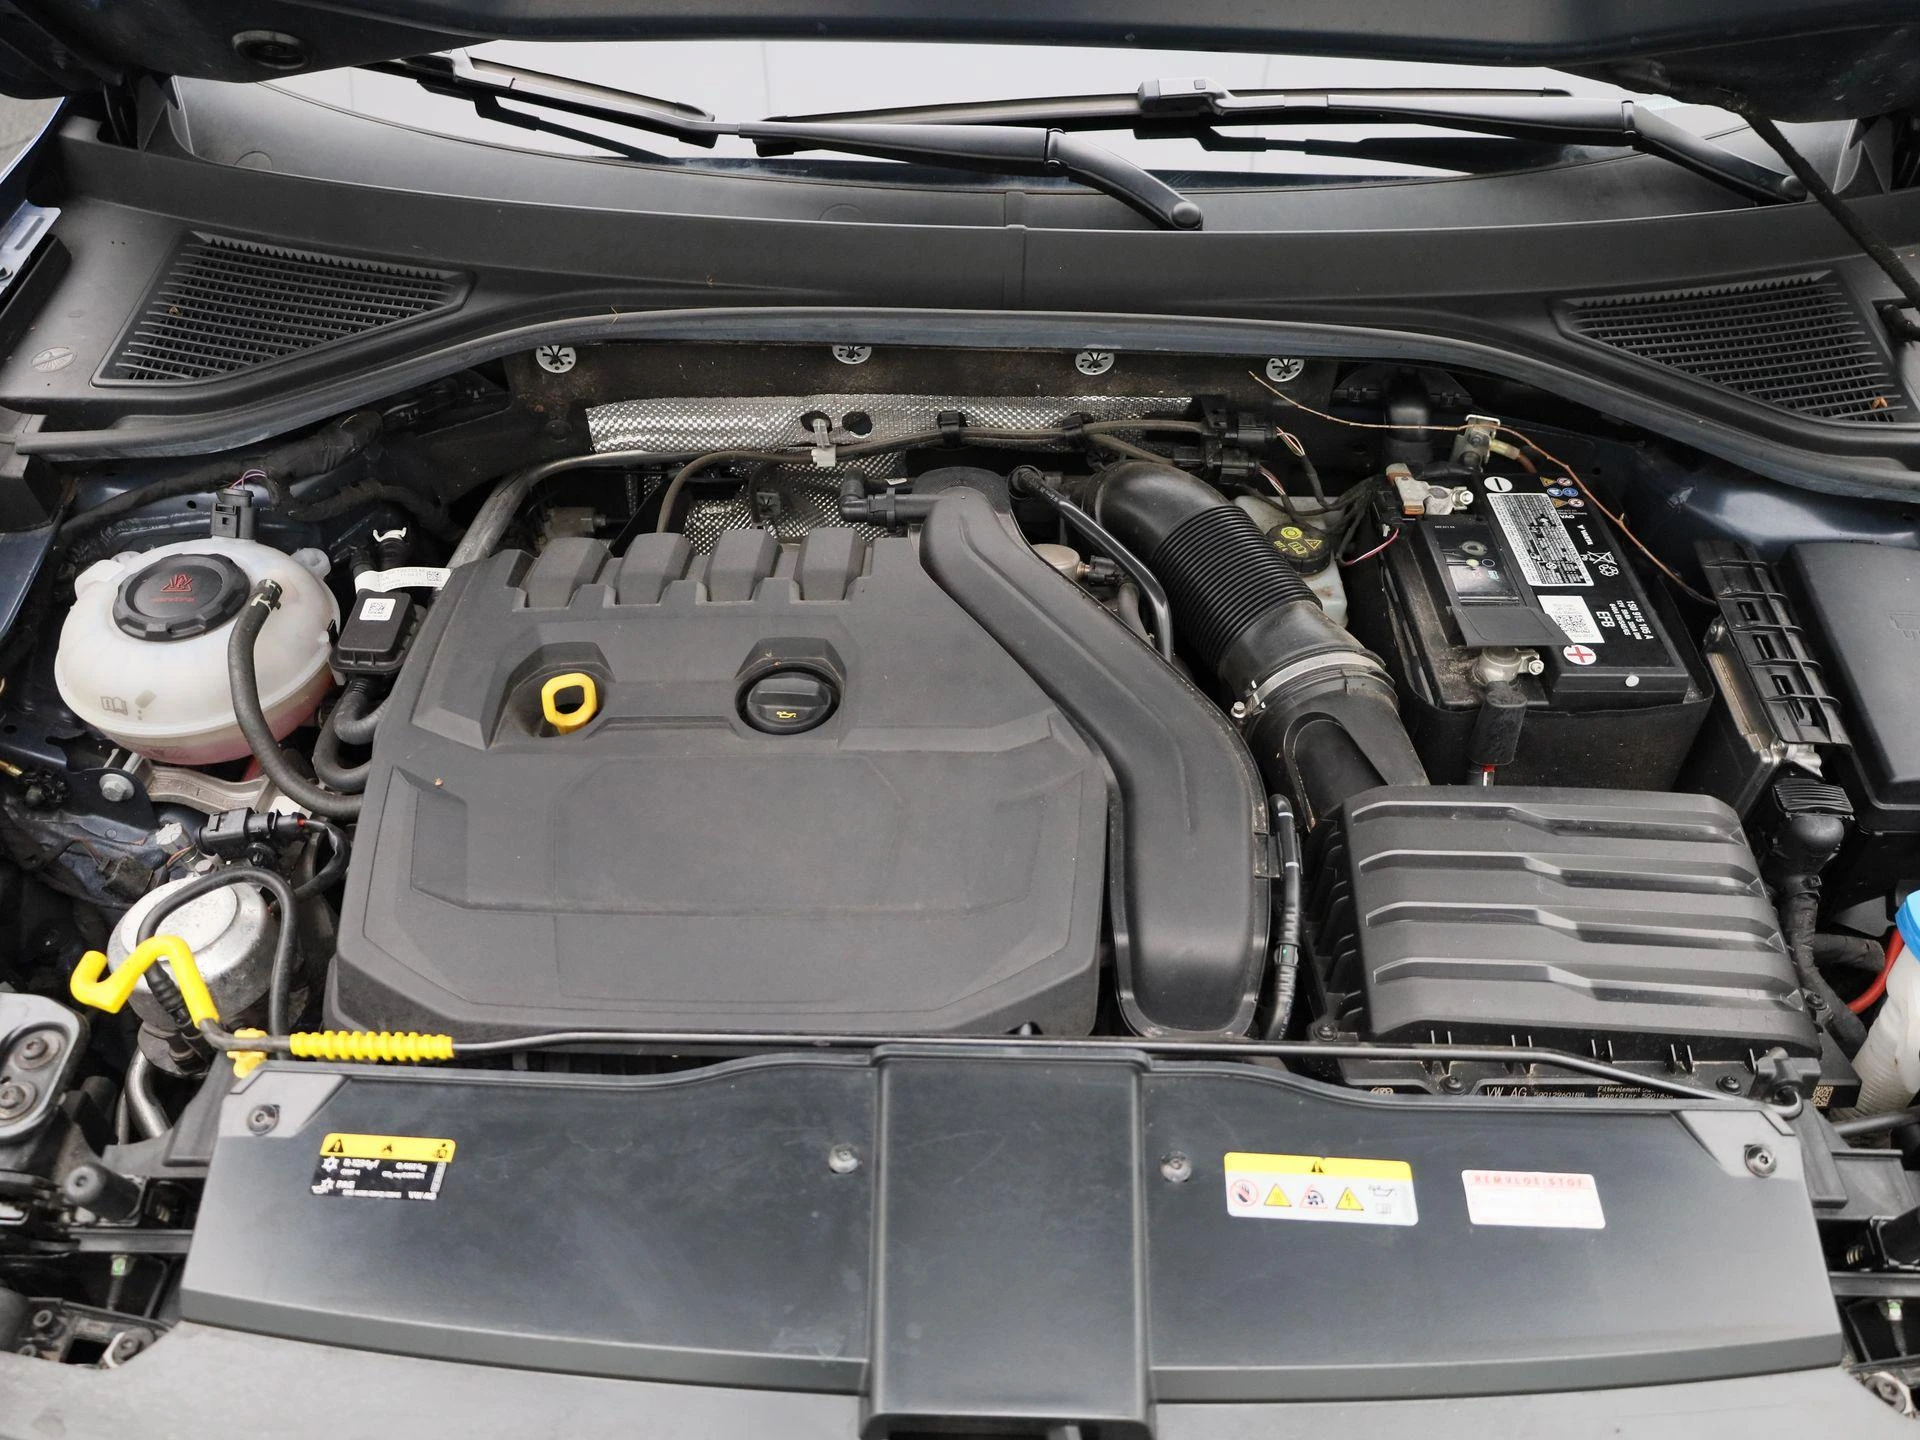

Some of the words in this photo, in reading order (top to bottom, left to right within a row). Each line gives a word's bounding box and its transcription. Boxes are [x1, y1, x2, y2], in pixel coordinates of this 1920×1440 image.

[1595, 611, 1616, 628] EFB
[1632, 611, 1645, 623] 915
[1486, 1086, 1504, 1098] VW
[1510, 1086, 1527, 1098] AG
